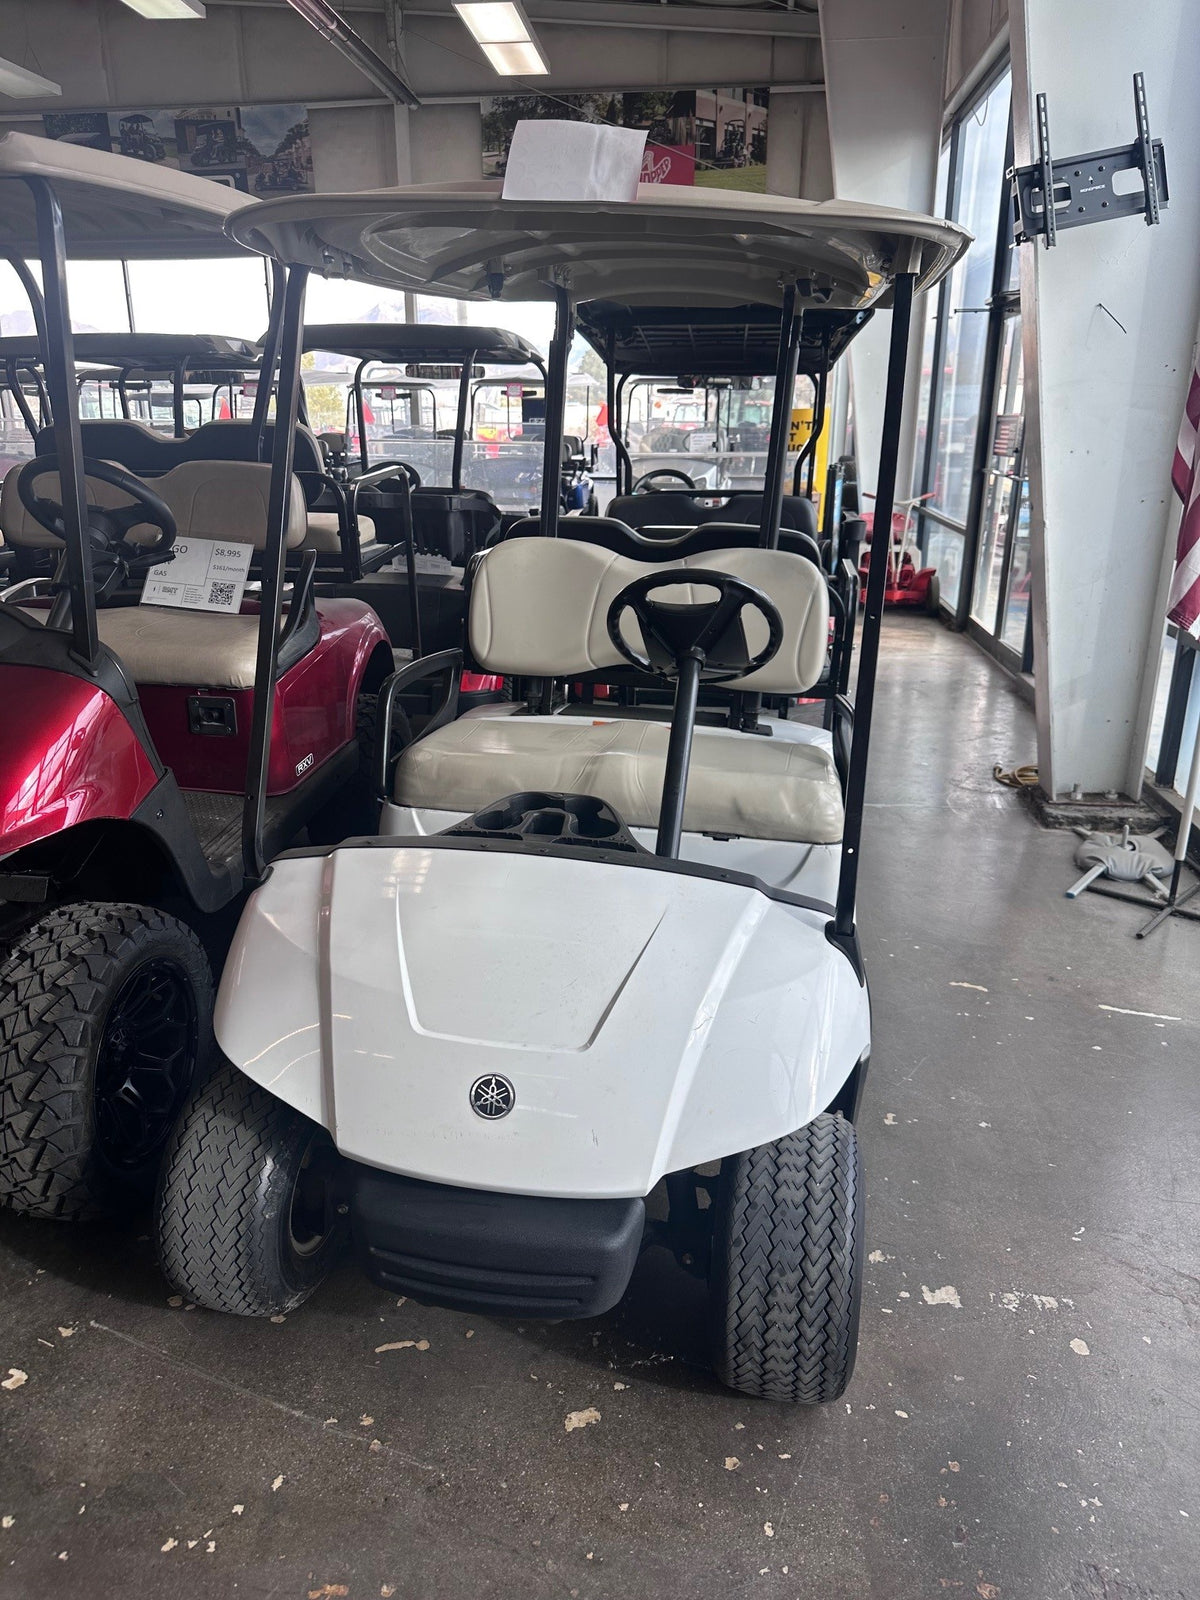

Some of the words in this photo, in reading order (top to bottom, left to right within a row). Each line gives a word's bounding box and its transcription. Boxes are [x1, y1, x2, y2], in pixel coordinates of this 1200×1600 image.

[790, 421, 812, 431] N'T
[172, 544, 188, 554] GO
[215, 548, 242, 558] $8,995
[153, 569, 168, 577] GAS
[212, 564, 246, 573] $161/month
[297, 754, 313, 774] RXV
